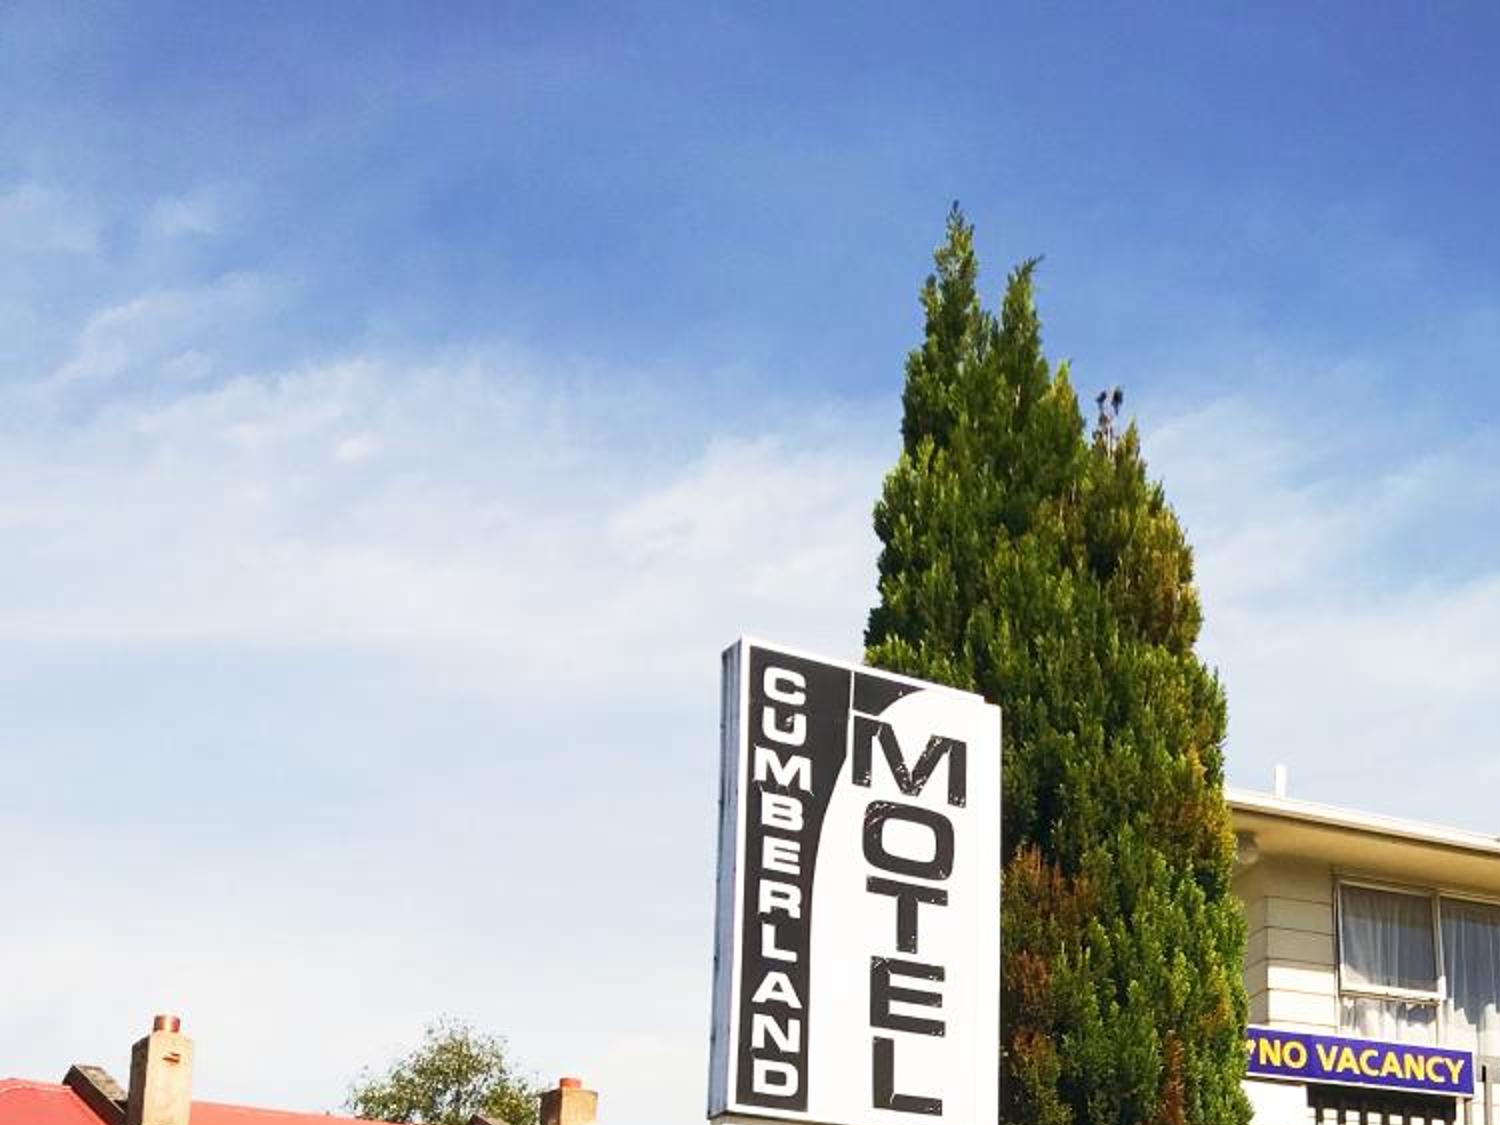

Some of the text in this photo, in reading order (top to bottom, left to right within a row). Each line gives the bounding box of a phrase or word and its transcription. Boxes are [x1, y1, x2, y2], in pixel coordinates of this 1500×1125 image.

[752, 666, 814, 1097] CUMBERLAND
[851, 714, 967, 1117] MOTEL
[1259, 1037, 1464, 1085] NO VACANCY
